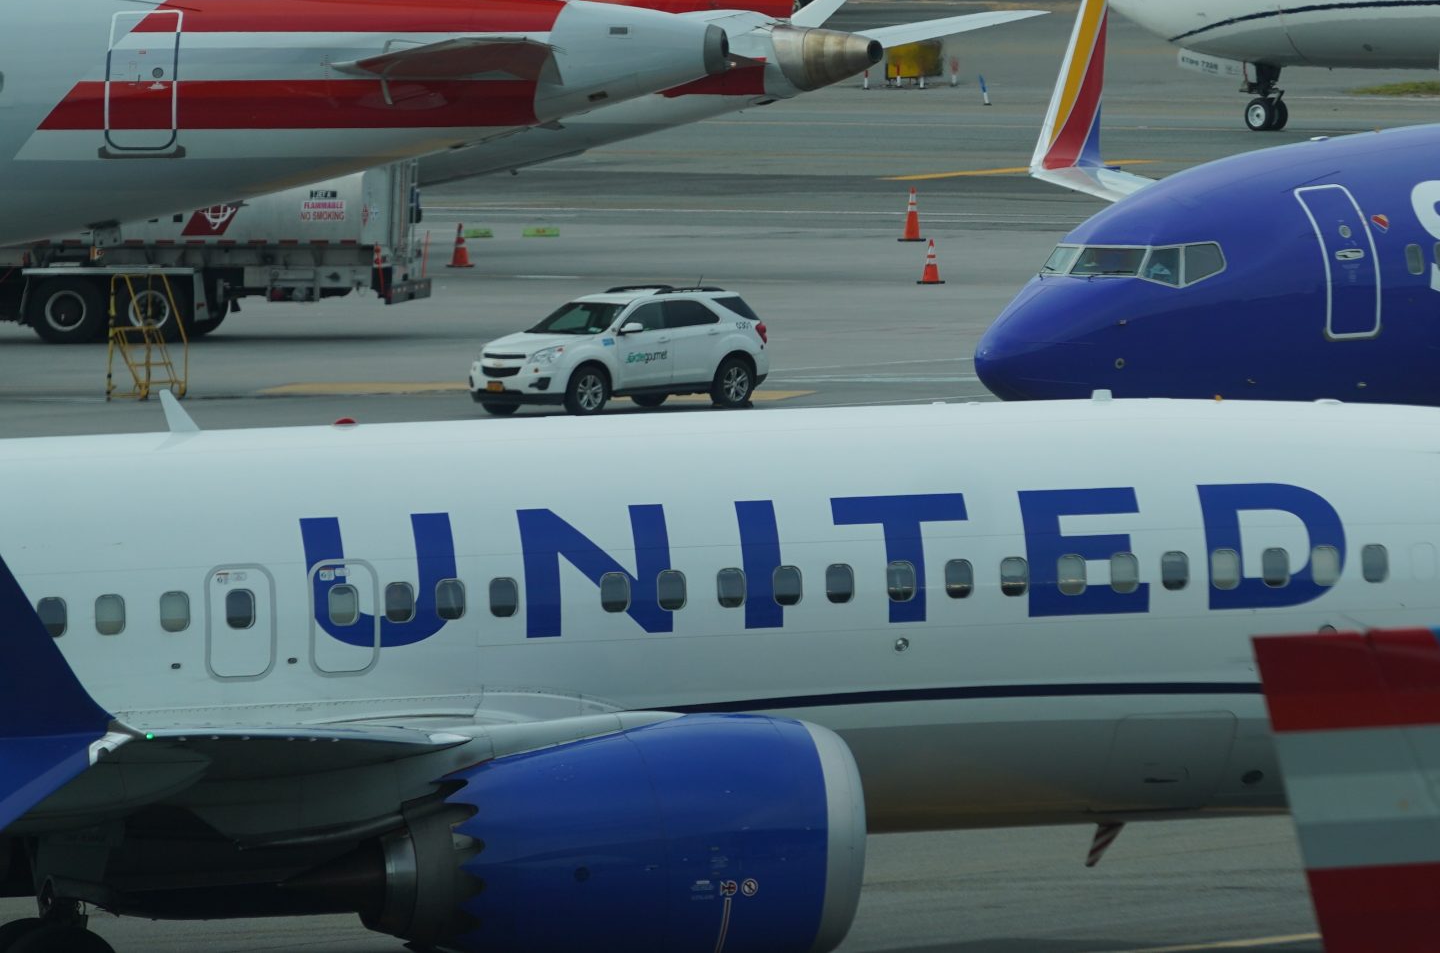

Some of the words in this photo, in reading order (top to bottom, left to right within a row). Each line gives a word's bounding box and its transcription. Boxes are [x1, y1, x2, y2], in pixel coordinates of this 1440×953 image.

[303, 201, 344, 209] FLAMMABLE
[300, 211, 311, 220] NO
[312, 211, 345, 220] SMOKING
[300, 483, 1346, 648] UNITED
